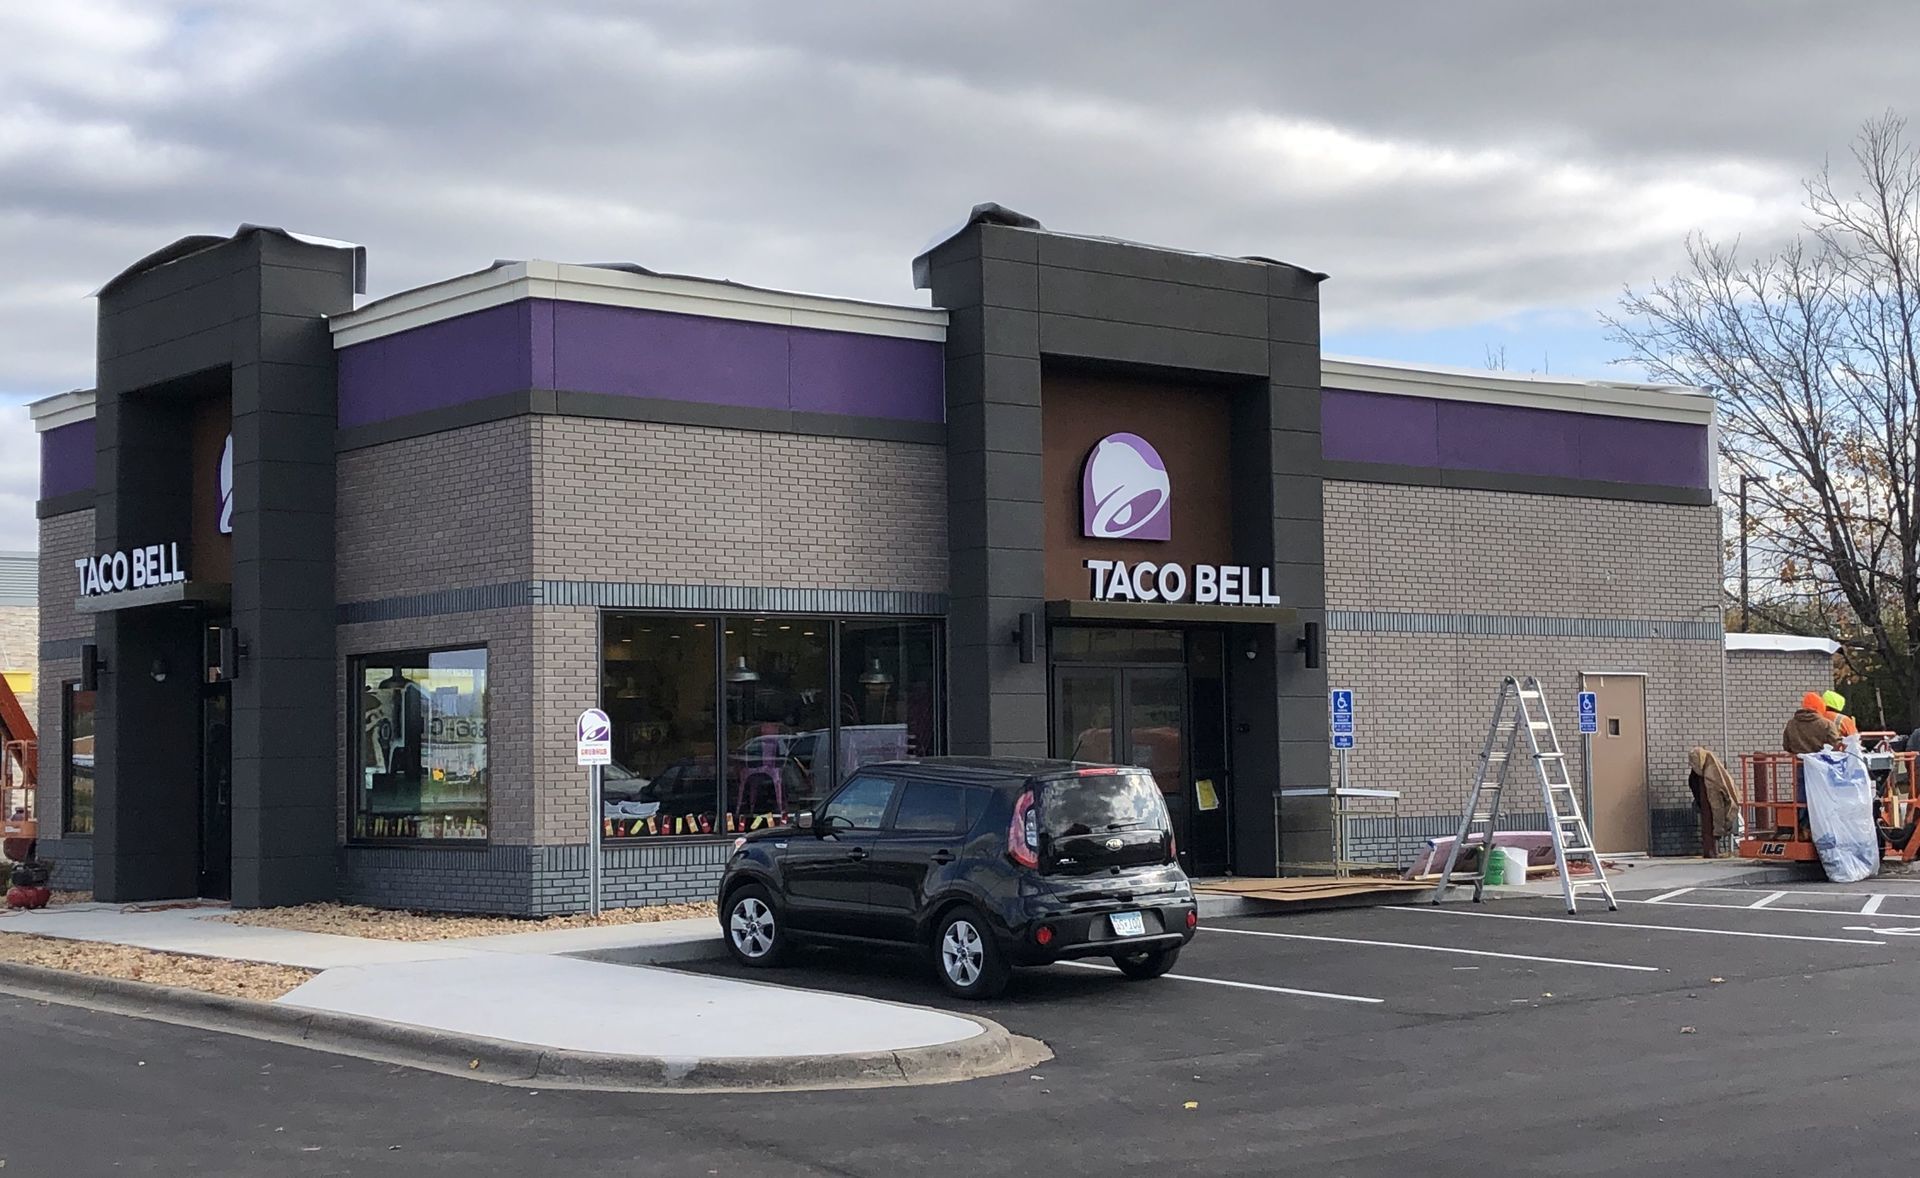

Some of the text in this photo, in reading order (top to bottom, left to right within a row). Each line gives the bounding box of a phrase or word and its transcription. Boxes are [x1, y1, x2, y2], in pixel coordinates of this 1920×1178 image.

[74, 541, 185, 596] TACO BELL
[1087, 559, 1281, 605] TACO BELL
